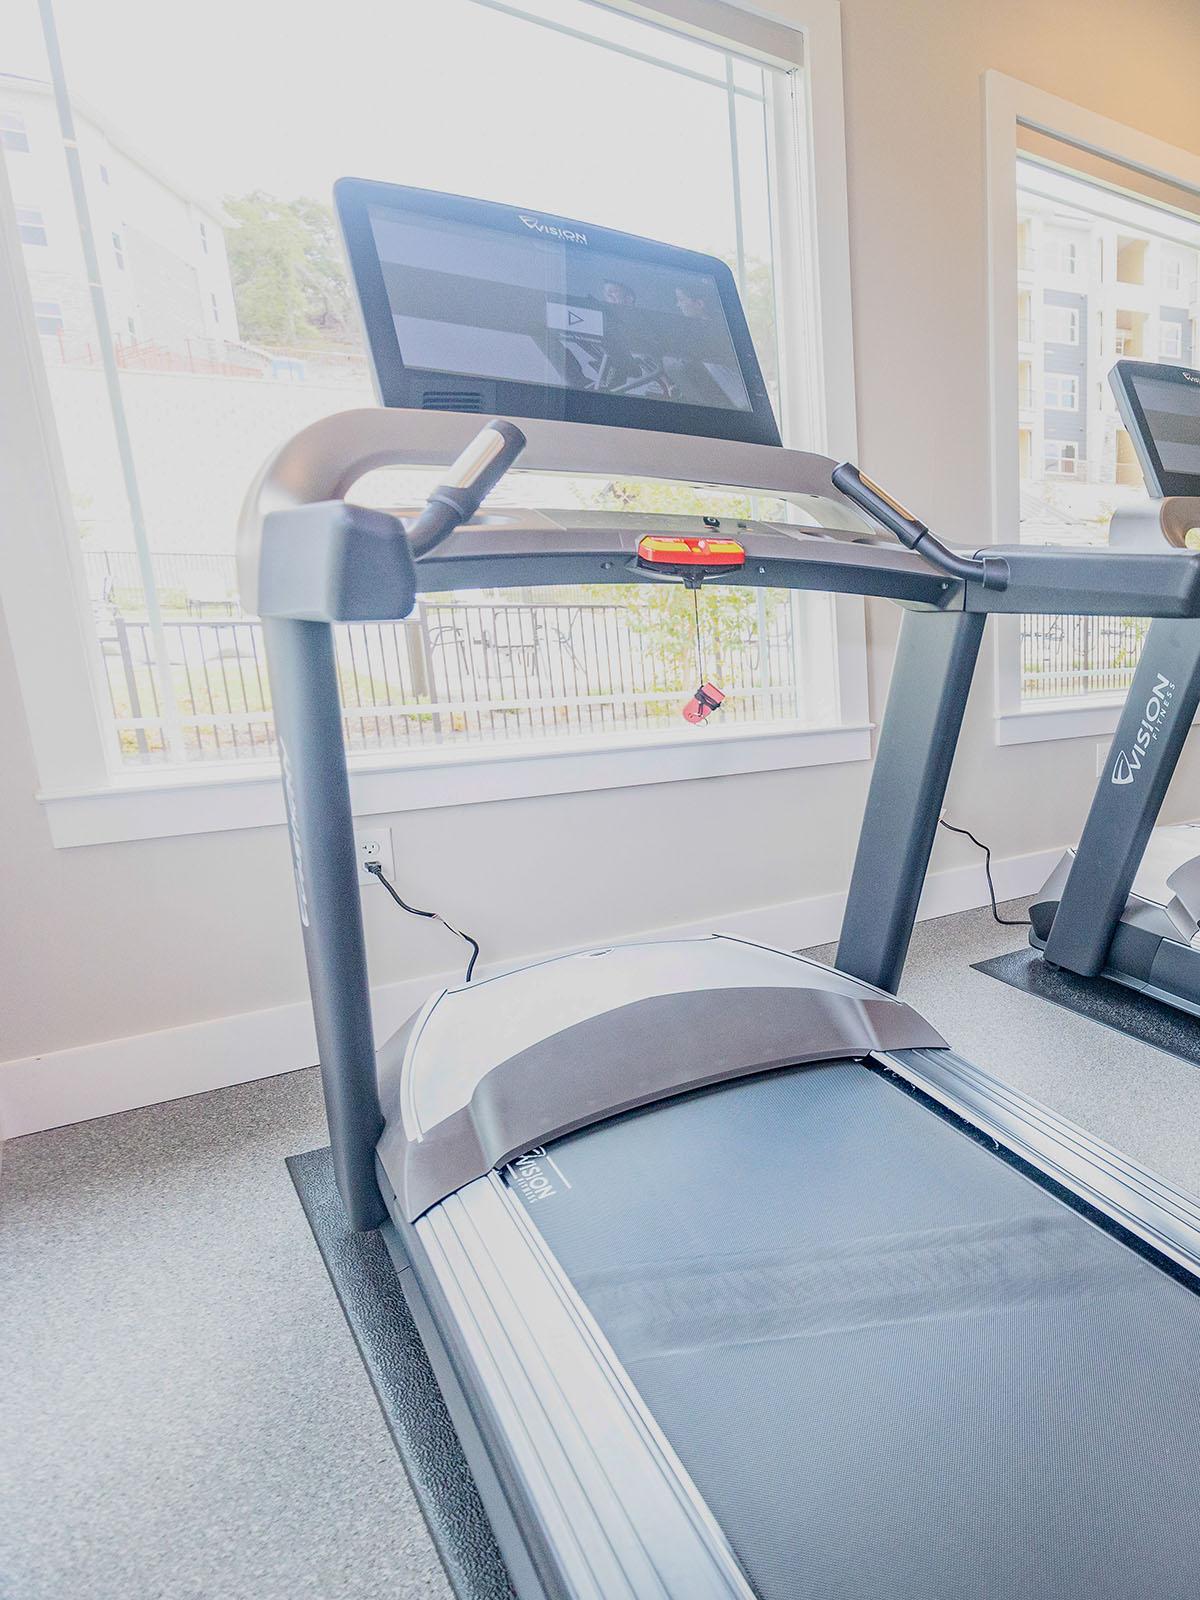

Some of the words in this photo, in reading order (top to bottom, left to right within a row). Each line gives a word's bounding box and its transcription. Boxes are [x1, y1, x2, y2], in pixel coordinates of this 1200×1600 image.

[536, 223, 588, 243] VISION
[1130, 672, 1170, 770] VISION
[1153, 682, 1175, 740] FITNESS
[516, 1157, 557, 1200] VISION
